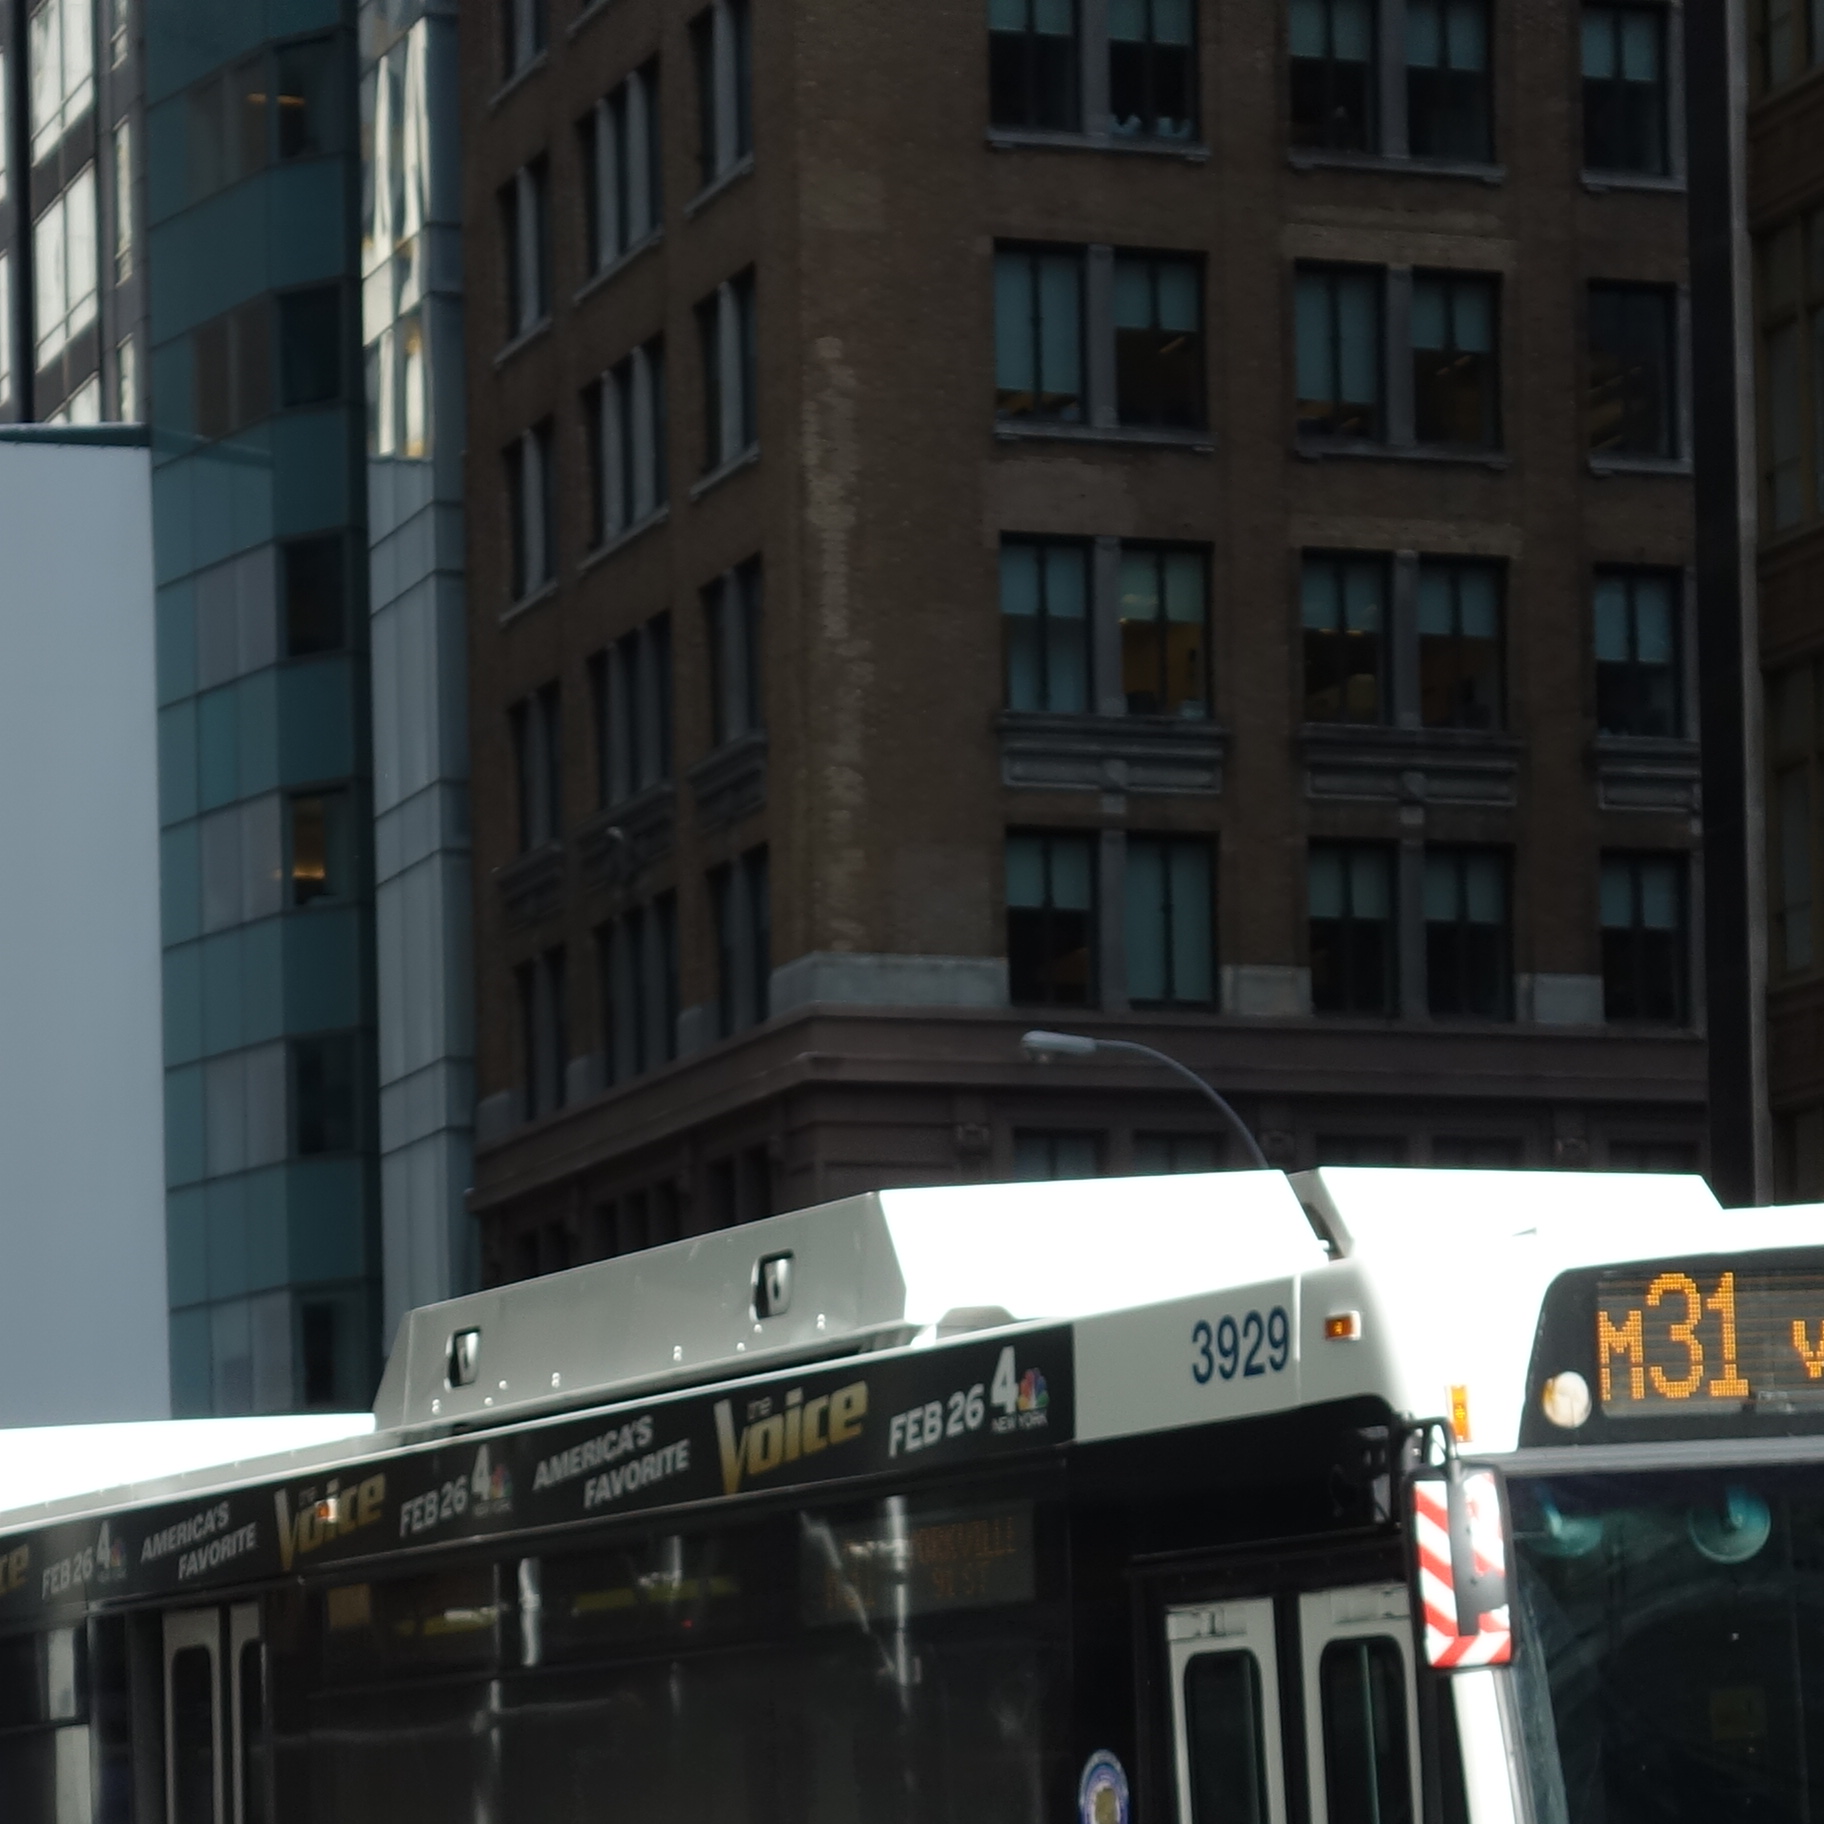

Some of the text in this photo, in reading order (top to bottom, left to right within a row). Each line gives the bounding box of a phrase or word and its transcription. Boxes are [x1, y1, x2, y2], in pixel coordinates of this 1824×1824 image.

[1191, 1303, 1290, 1385] 3929
[1598, 1272, 1750, 1400] M31
[713, 1379, 870, 1496] Voice
[888, 1345, 1019, 1459] FEB 26 4
[991, 1409, 1049, 1434] NEW YORK
[399, 1443, 492, 1539] FEB 26 4
[532, 1414, 654, 1493] AMERICA'S
[583, 1438, 691, 1511] FAVORITE
[140, 1501, 231, 1564] AMERICA'S
[177, 1521, 259, 1582] FAVORITE
[41, 1562, 71, 1601] FEB
[72, 1546, 94, 1584] 26
